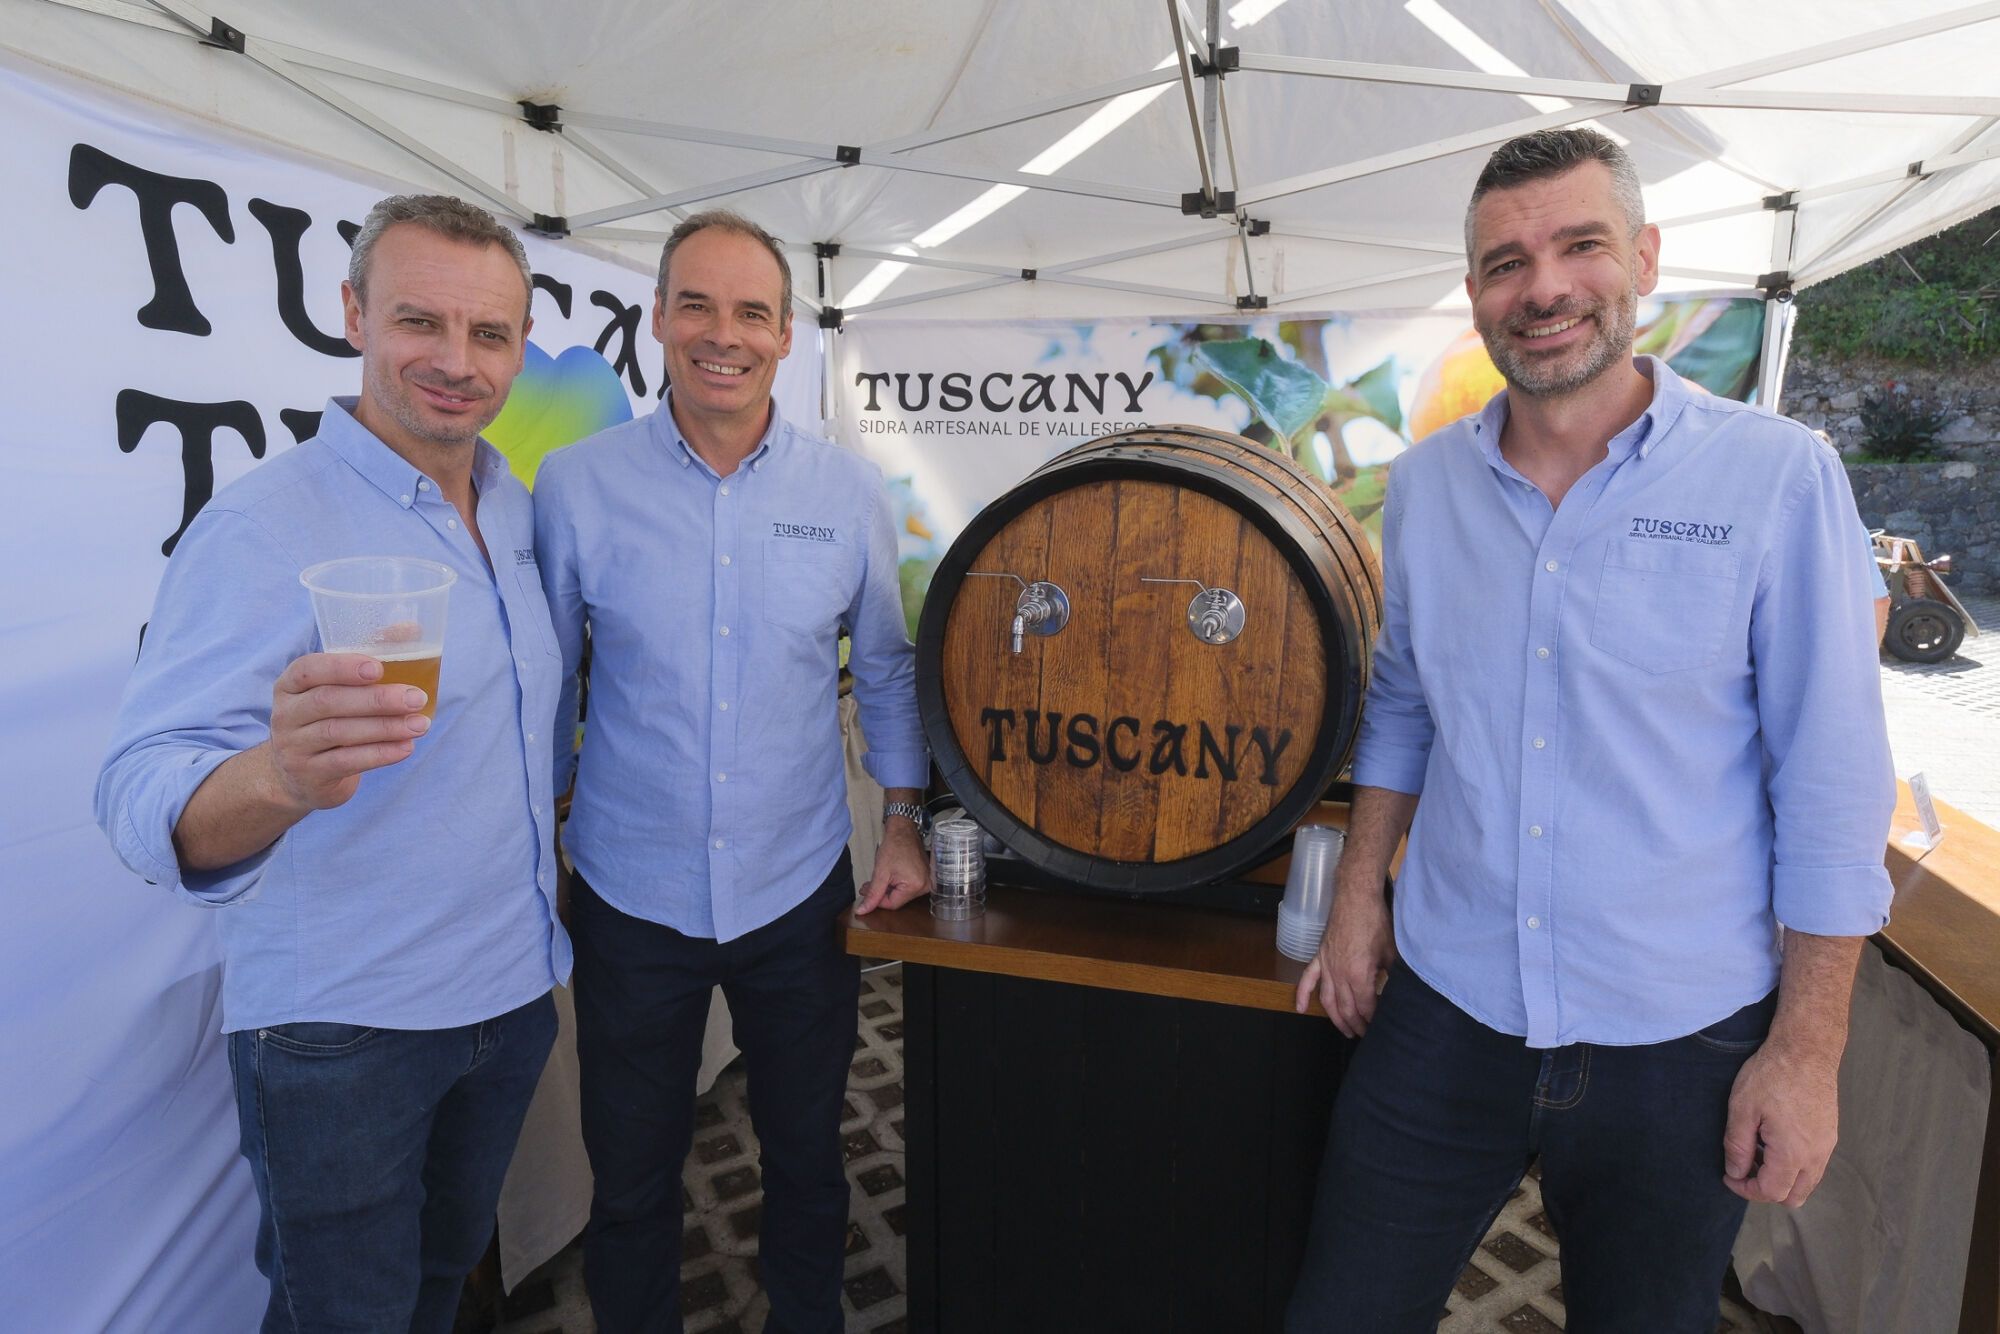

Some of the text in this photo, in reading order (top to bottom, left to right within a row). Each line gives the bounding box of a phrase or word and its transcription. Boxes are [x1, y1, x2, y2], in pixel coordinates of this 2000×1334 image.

[855, 371, 1154, 415] TUSCANY
[859, 420, 908, 434] SIDRA
[913, 420, 1012, 436] ARTESANAL
[1019, 421, 1040, 436] DE
[773, 522, 836, 539] TUSCANY
[1631, 517, 1733, 540] TUSCANY
[981, 708, 1291, 785] TUSCANY
